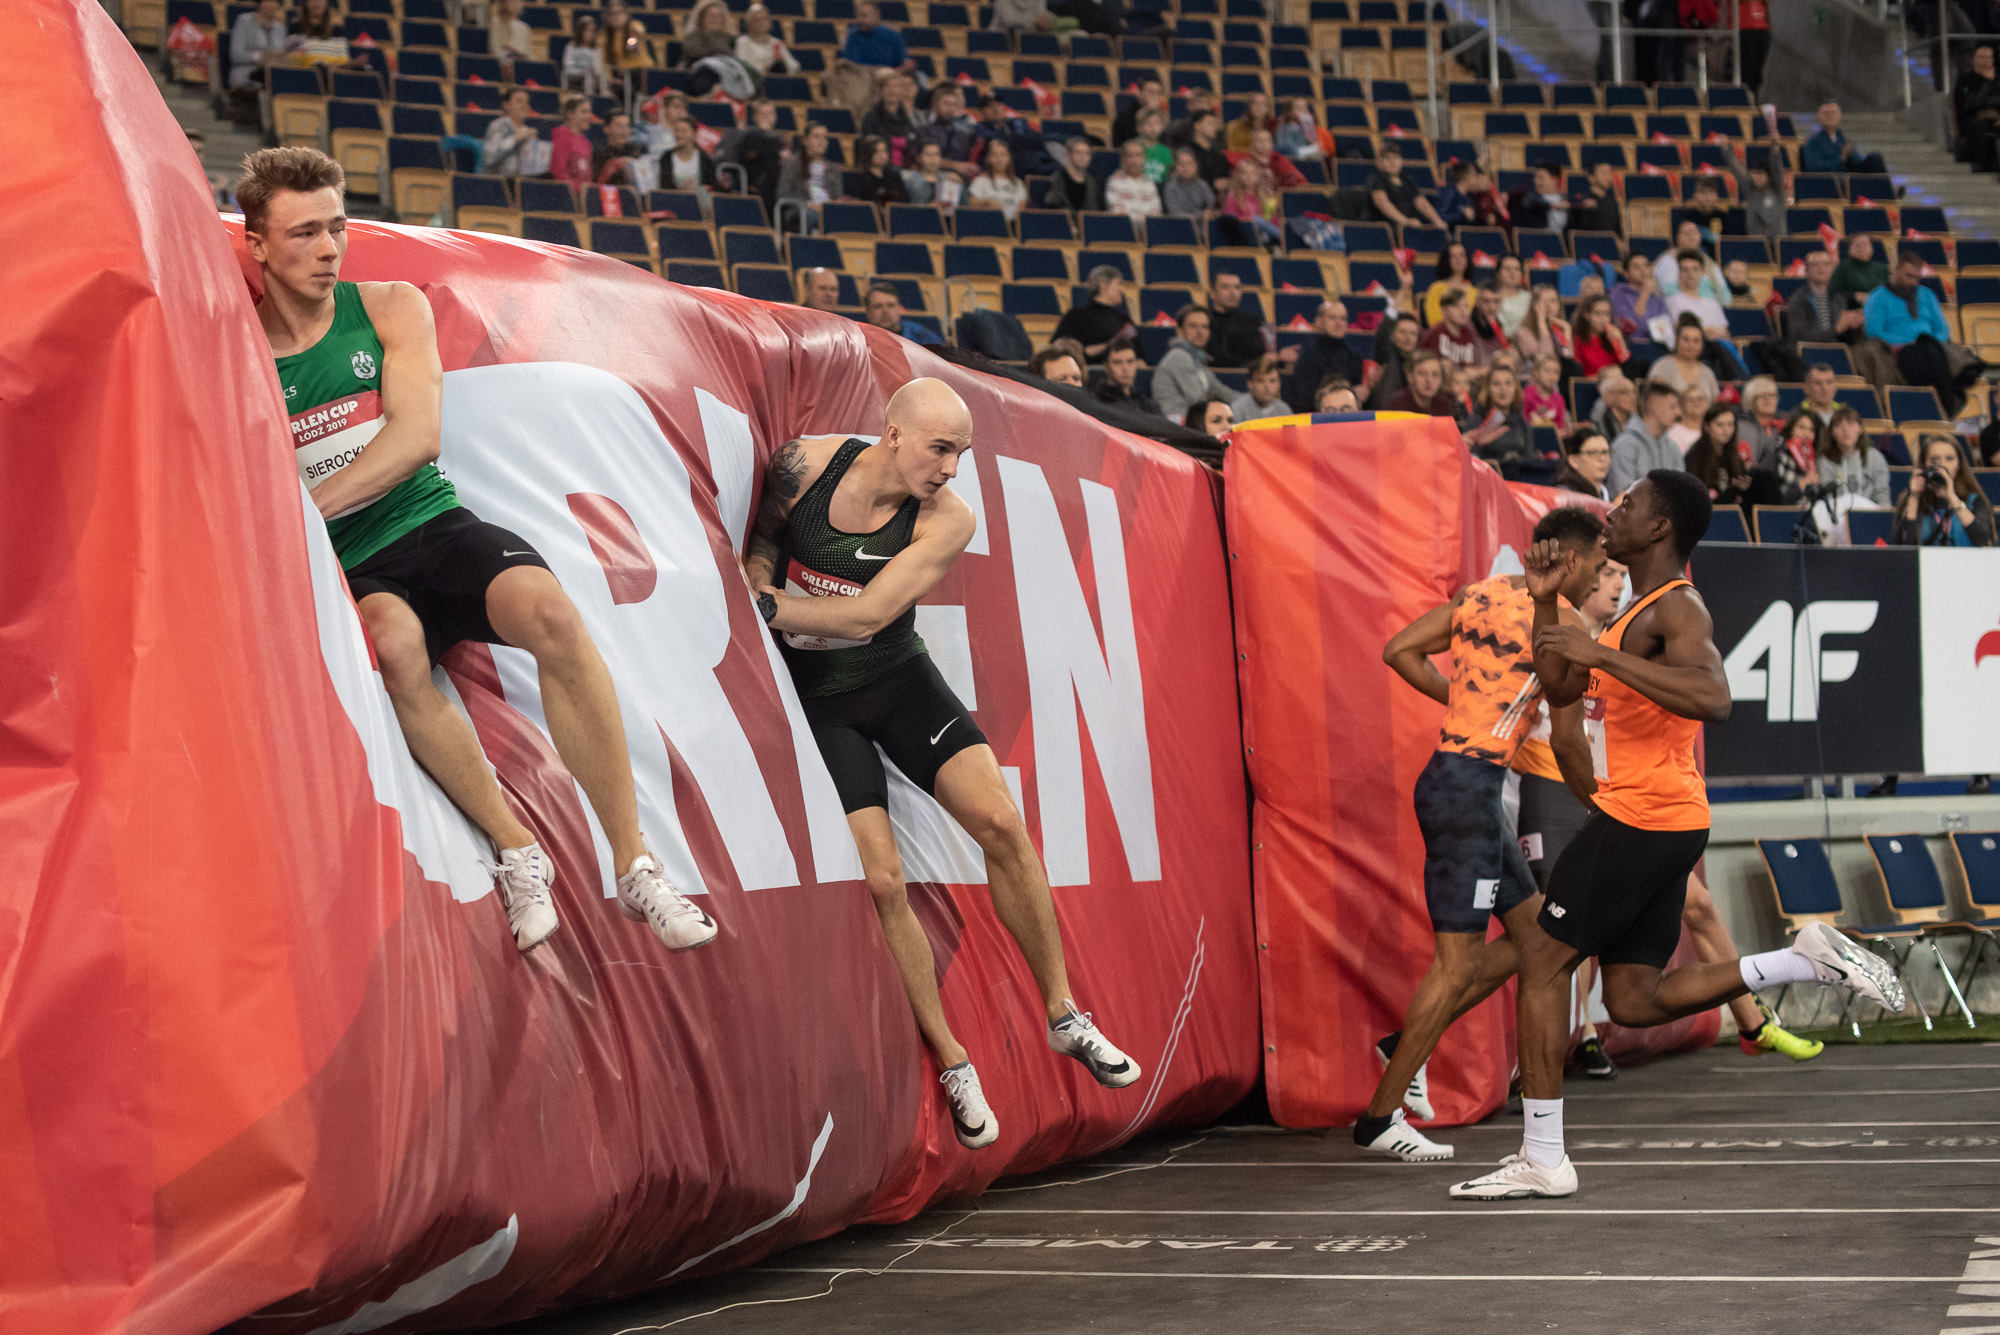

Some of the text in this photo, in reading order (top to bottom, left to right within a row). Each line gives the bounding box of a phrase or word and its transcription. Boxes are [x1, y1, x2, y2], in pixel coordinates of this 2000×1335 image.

[329, 400, 359, 418] CUP
[326, 418, 348, 433] 2019
[801, 571, 839, 592] ORLEN
[1723, 599, 1880, 722] 4F
[1522, 840, 1531, 858] 6
[885, 1238, 1294, 1250] TAMEX
